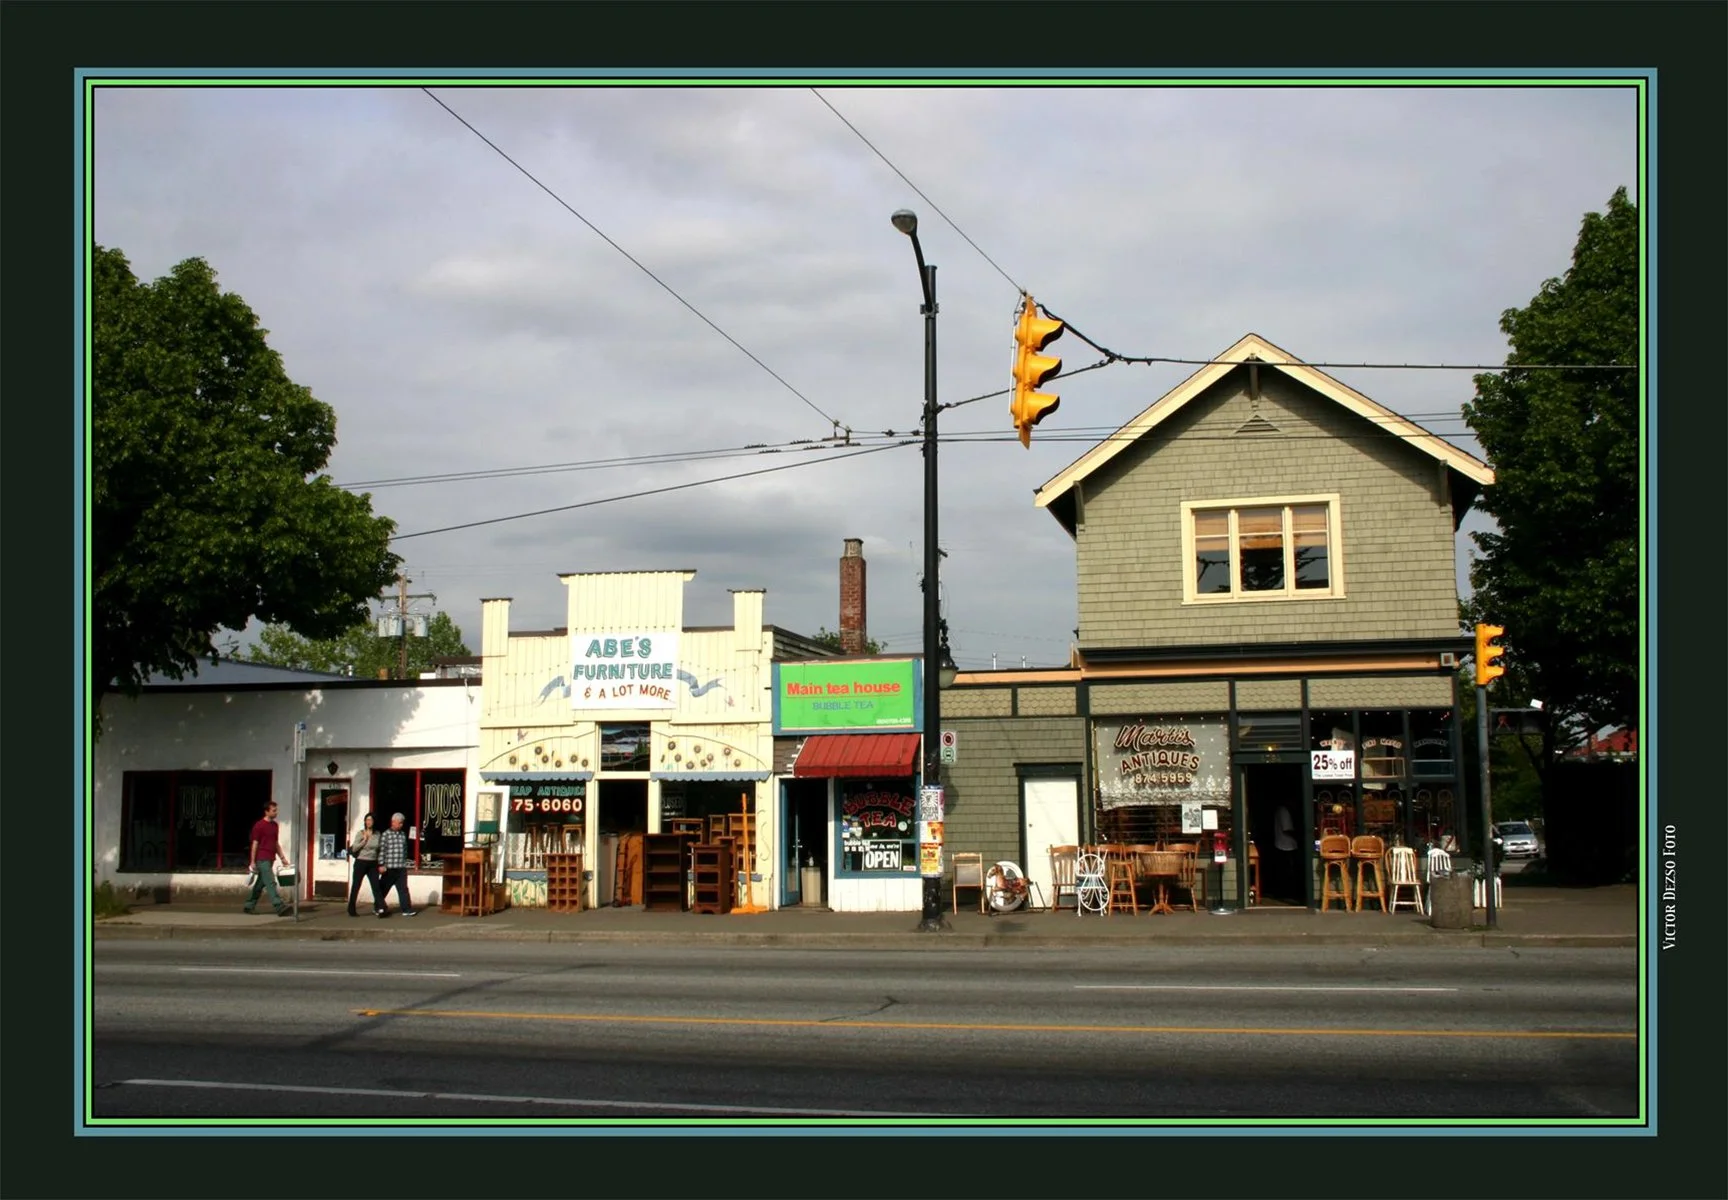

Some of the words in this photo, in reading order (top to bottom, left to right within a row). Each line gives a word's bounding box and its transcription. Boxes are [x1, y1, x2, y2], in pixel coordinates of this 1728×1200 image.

[585, 636, 652, 658] ABE'S
[573, 663, 673, 680] FURNITURE
[599, 688, 606, 699] A
[612, 684, 634, 698] LOT
[639, 684, 671, 700] MORE
[787, 683, 823, 695] Main
[826, 682, 850, 694] tea
[854, 681, 901, 694] house
[812, 701, 851, 711] BUBBLE
[854, 700, 874, 710] TEA
[1121, 750, 1201, 774] ANTIQUES
[1313, 754, 1338, 770] 25%
[1340, 757, 1353, 770] off
[423, 783, 462, 828] JOJO'S
[843, 791, 916, 817] BUBBLE
[859, 810, 897, 828] TEA
[865, 850, 899, 868] OPEN
